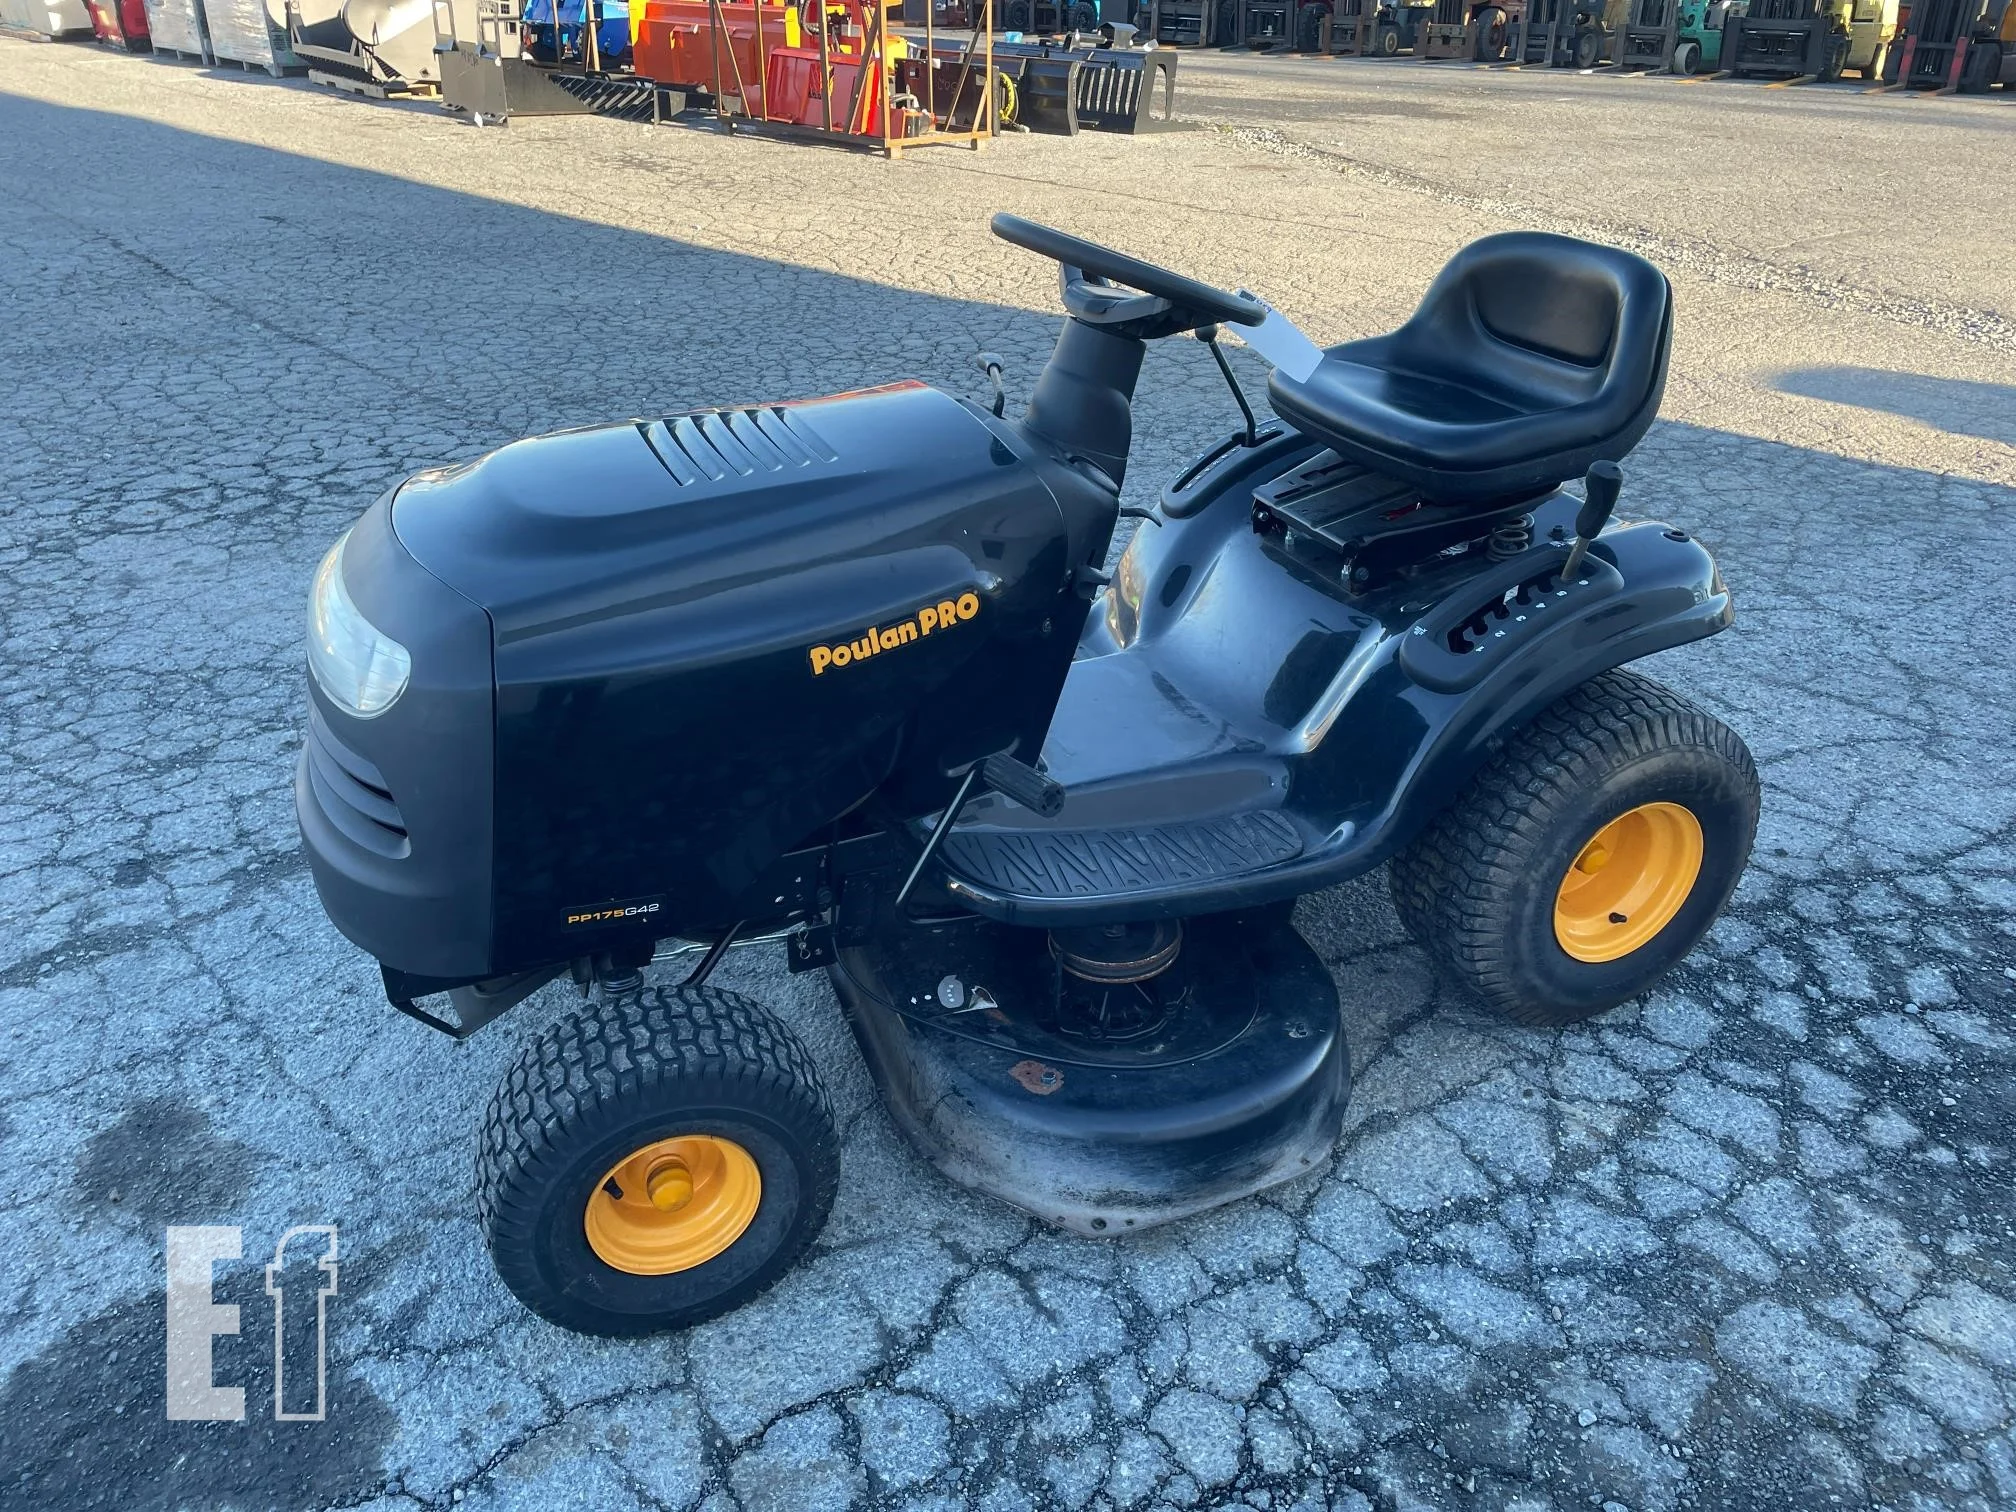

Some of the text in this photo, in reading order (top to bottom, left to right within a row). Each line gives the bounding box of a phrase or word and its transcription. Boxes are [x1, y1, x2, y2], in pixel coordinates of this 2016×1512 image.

[809, 592, 980, 675] Poulan PRO
[567, 903, 660, 924] PP175G42
